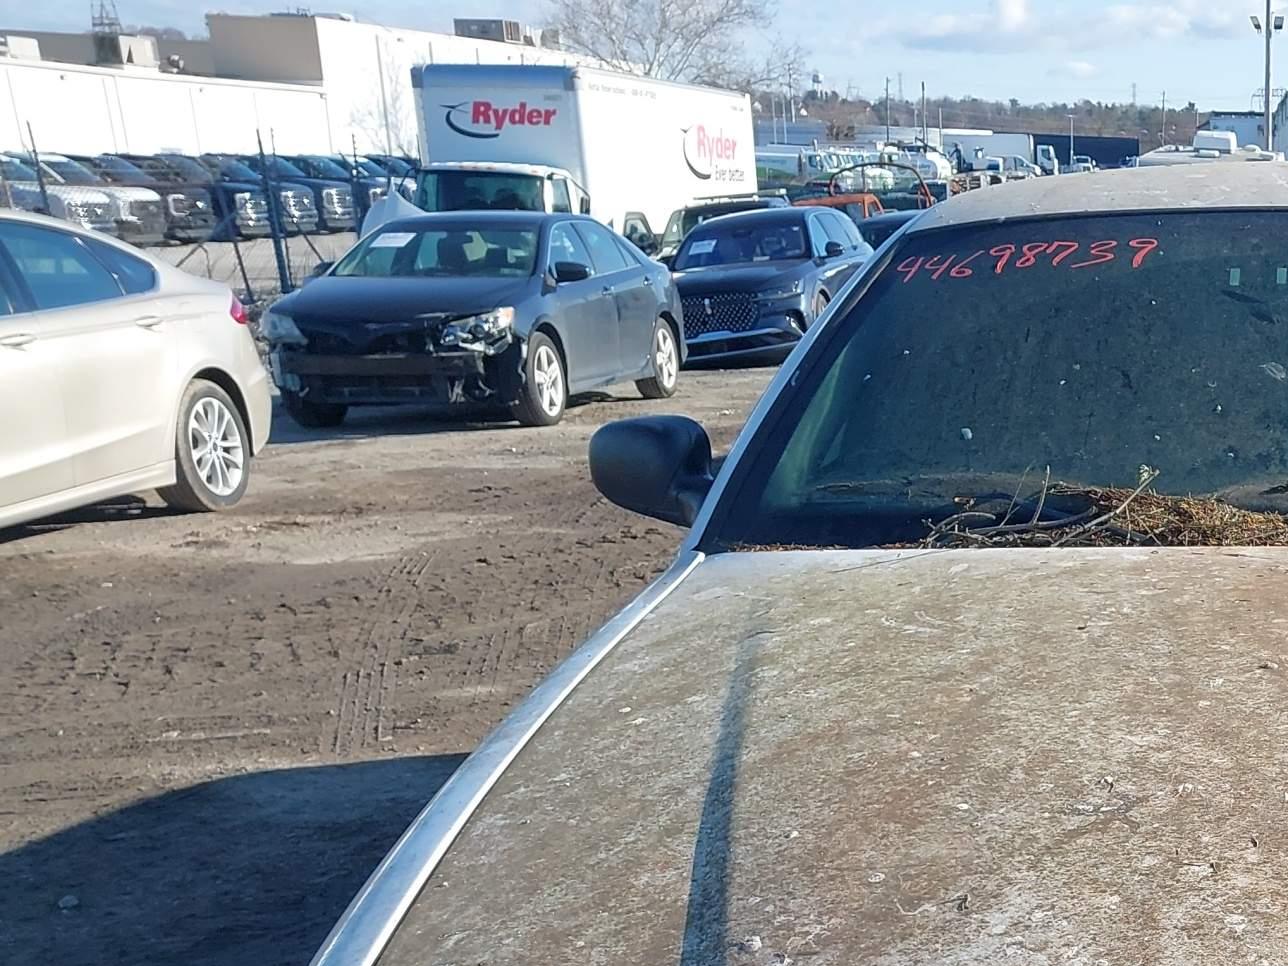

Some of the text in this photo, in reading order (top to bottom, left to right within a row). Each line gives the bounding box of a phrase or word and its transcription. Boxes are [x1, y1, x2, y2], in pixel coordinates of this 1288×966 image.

[472, 101, 557, 130] Ryder
[697, 124, 736, 167] Ryder
[897, 238, 1159, 283] 44698739
